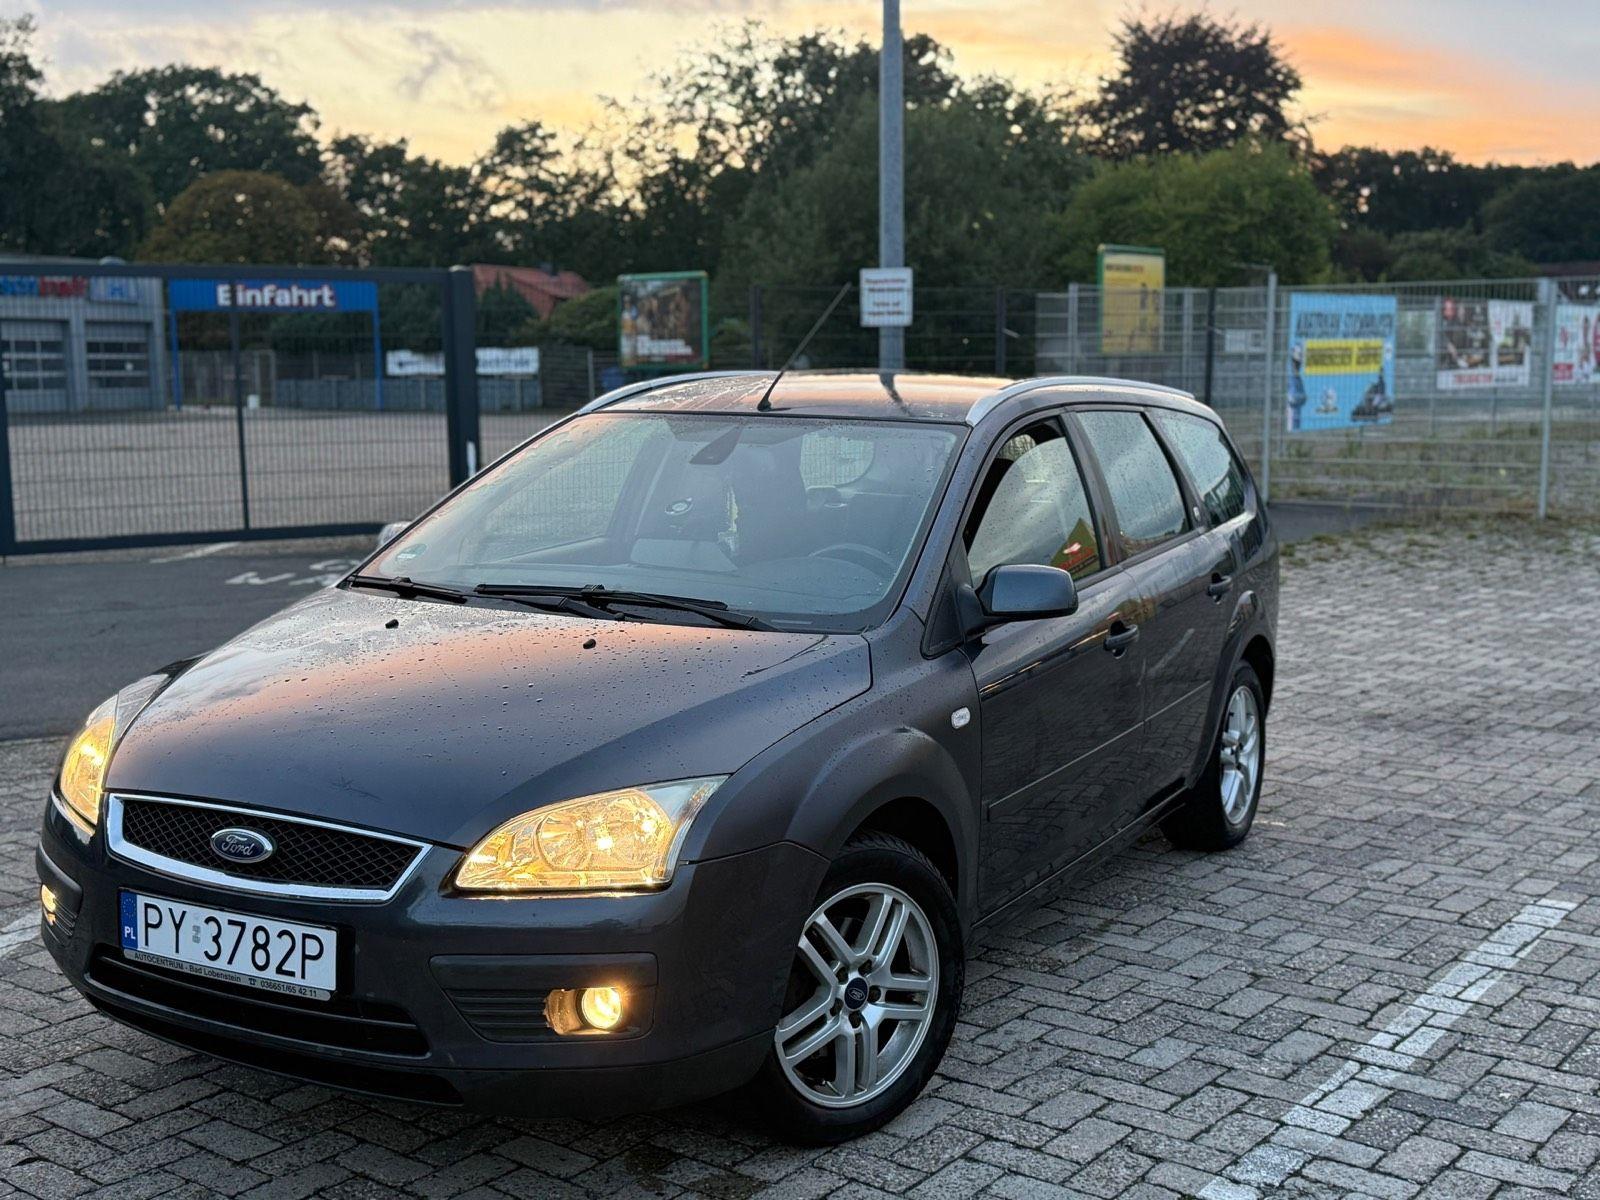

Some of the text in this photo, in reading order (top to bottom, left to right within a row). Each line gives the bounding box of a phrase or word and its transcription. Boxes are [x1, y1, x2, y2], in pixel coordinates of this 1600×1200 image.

[216, 284, 336, 307] Einfahrt
[221, 834, 255, 856] Ford
[124, 926, 136, 940] PL
[144, 902, 325, 980] PY 3782P
[134, 952, 184, 970] AUTOCENTRUM
[189, 964, 203, 975] Bad
[203, 968, 241, 983] Lobenstein
[298, 987, 307, 996] 42
[309, 989, 318, 998] 11
